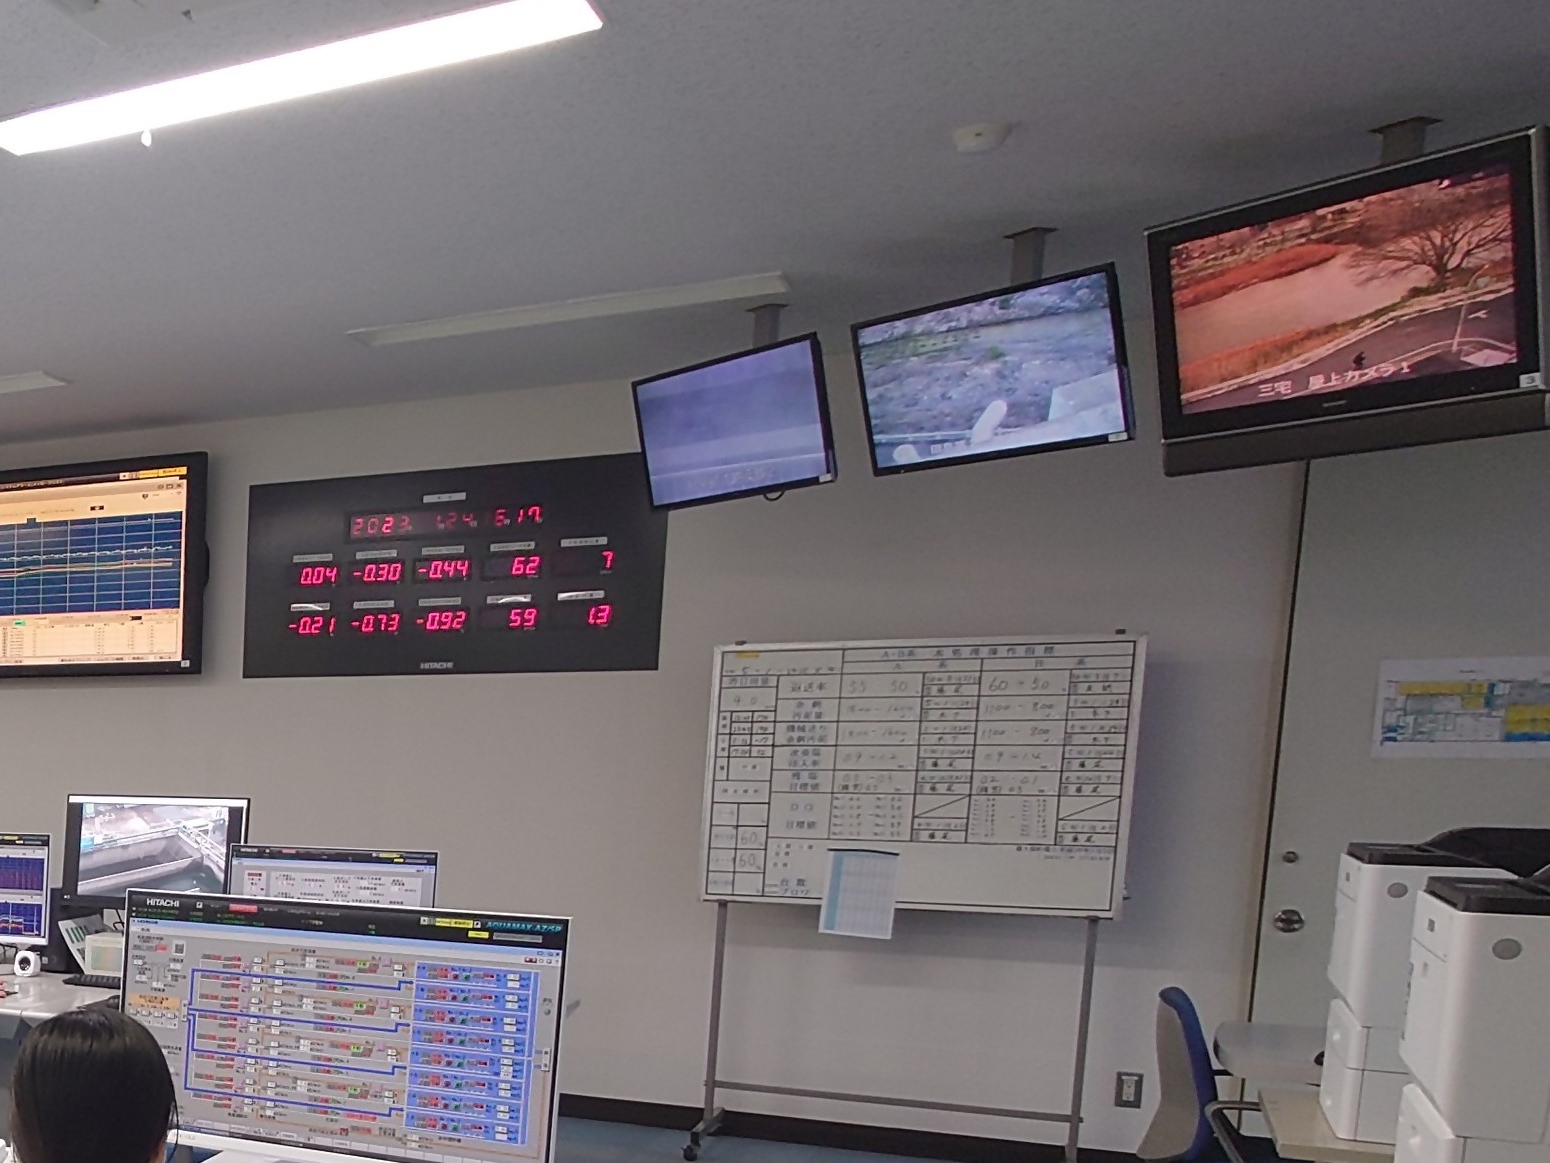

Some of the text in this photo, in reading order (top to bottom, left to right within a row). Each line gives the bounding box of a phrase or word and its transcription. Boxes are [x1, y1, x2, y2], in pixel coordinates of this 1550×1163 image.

[1257, 379, 1292, 397] 三宅
[511, 555, 541, 576] 62
[601, 550, 614, 569] 7
[509, 607, 538, 628] 59
[419, 661, 454, 670] HITACHI
[988, 677, 1009, 692] 60
[146, 898, 180, 908] HITACHI
